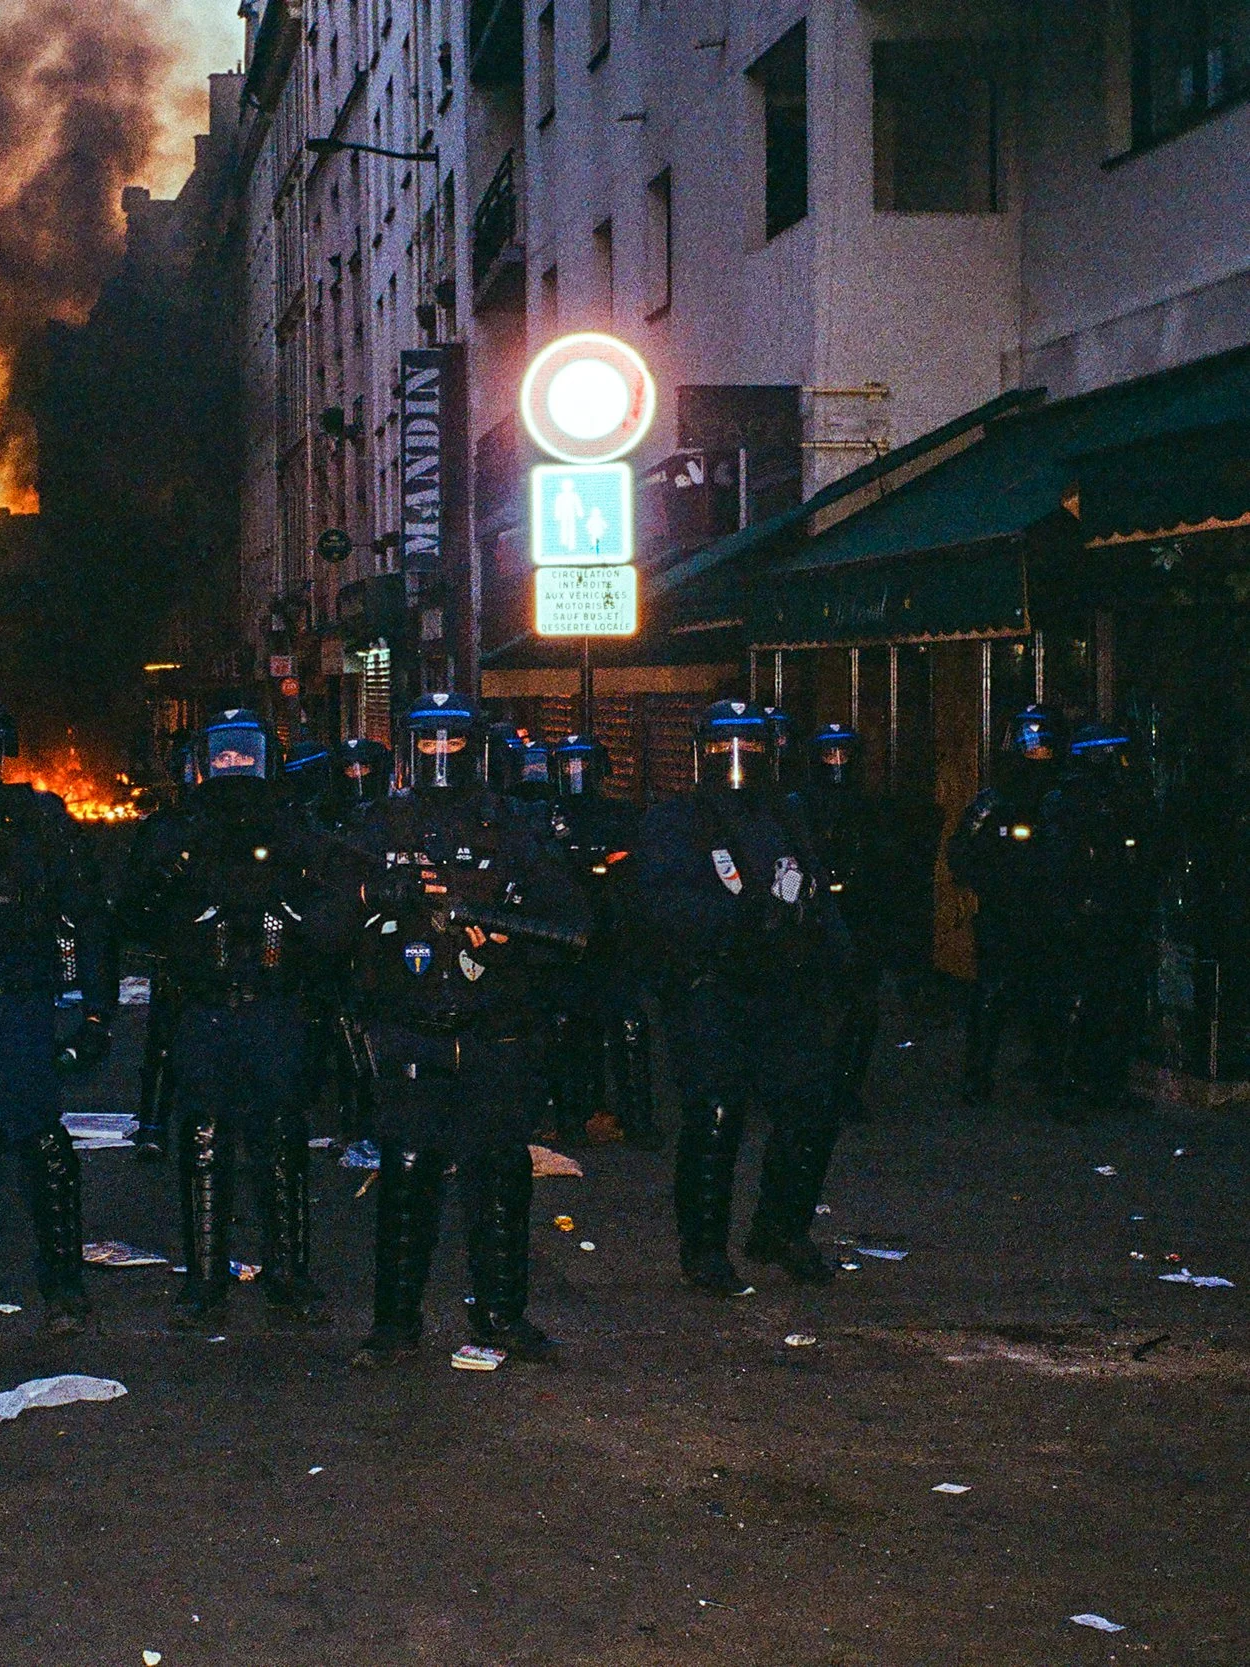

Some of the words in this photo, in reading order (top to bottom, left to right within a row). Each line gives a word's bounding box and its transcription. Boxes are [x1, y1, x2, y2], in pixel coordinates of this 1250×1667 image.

[405, 364, 441, 556] MANDIN
[551, 570, 620, 579] CIRCULATION
[558, 581, 613, 589] INTERDITE
[545, 592, 565, 600] AUX
[552, 613, 580, 621] SAUF
[583, 612, 603, 621] BUS
[607, 612, 620, 621] ET
[541, 624, 591, 633] DESSERTE
[594, 623, 631, 632] LOCALE
[405, 947, 430, 955] POLICE
